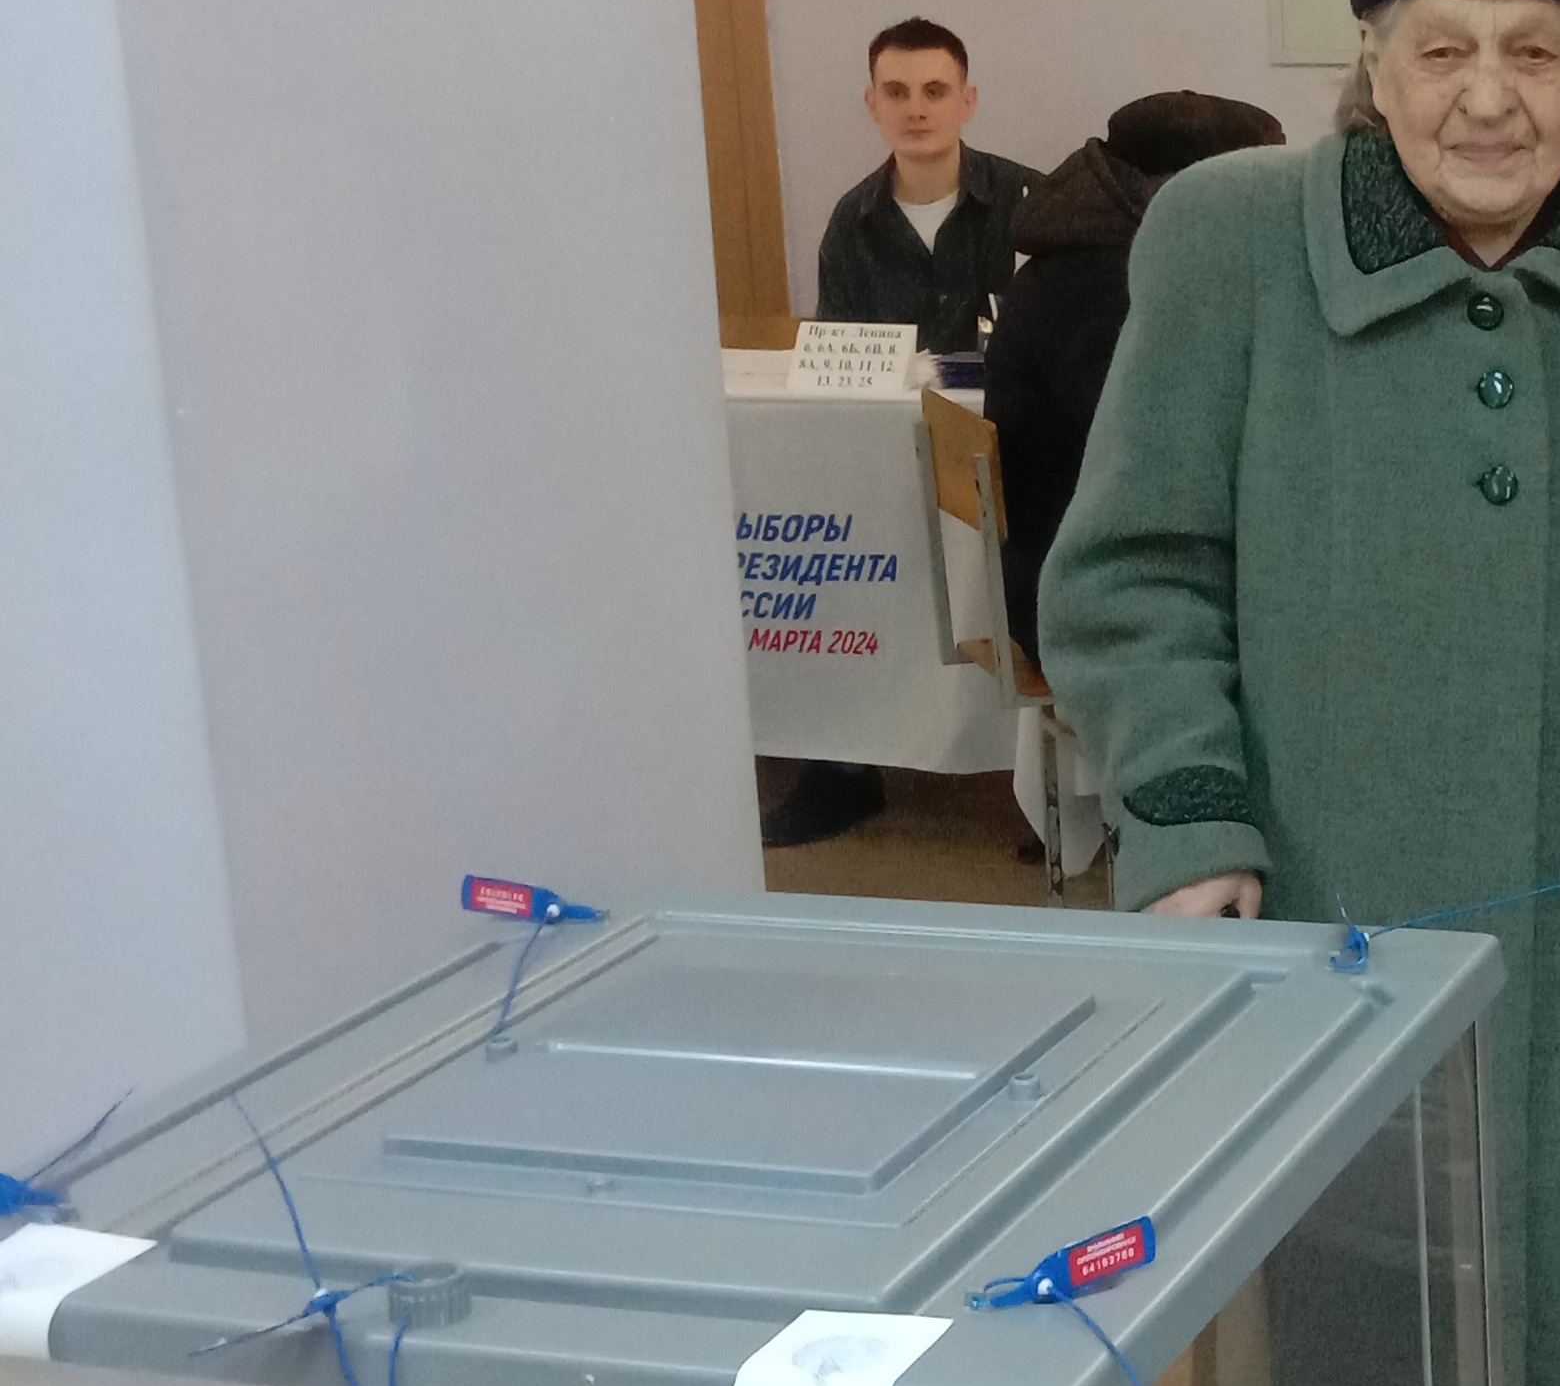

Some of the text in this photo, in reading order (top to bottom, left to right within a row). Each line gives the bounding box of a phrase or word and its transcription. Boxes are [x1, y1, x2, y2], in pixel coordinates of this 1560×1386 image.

[736, 512, 853, 543] ЫБОРЫ
[748, 627, 879, 656] МАРТА 2024
